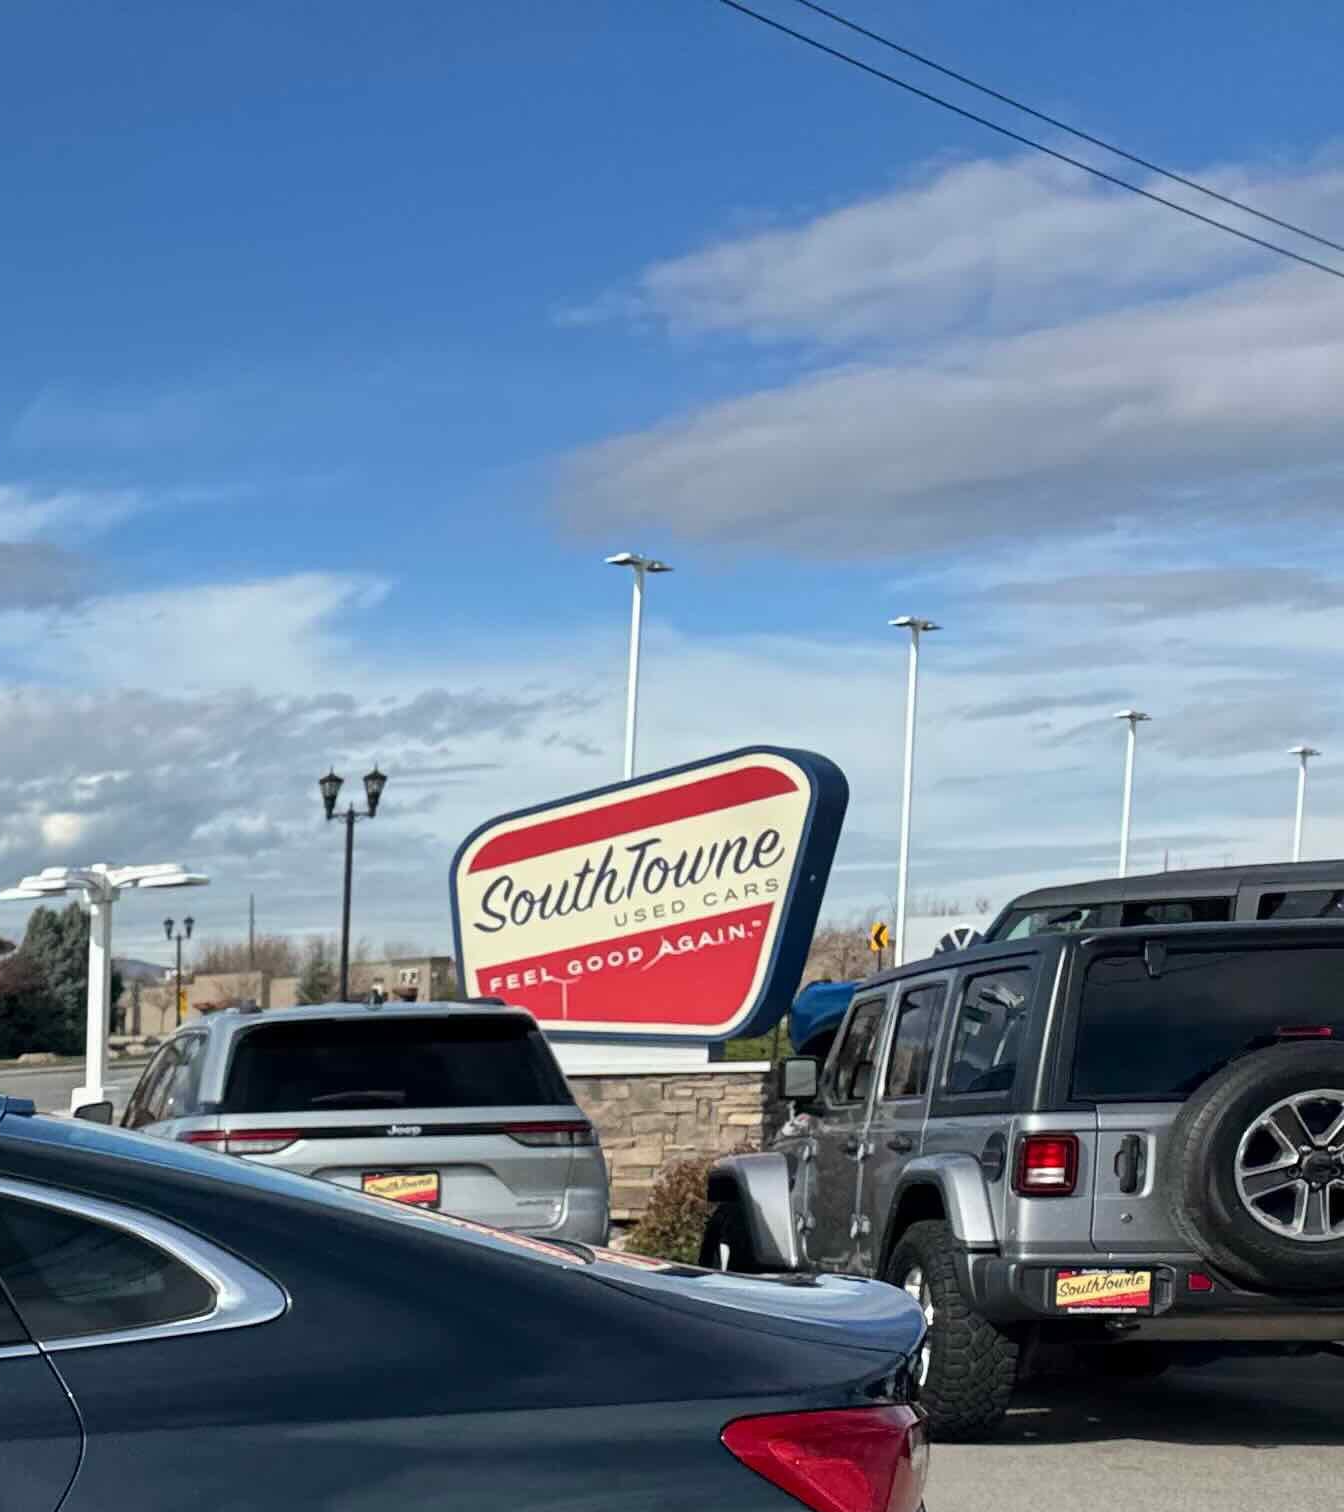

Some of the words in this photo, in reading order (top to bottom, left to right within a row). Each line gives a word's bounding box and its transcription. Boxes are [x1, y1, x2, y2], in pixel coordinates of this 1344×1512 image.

[473, 828, 786, 933] SouthTowne
[614, 900, 685, 927] USED
[703, 878, 780, 906] CARS
[489, 966, 554, 992] FEEL
[567, 946, 644, 975] GOOD
[386, 1124, 422, 1137] Jeep
[1058, 1274, 1146, 1297] SouthTowne
